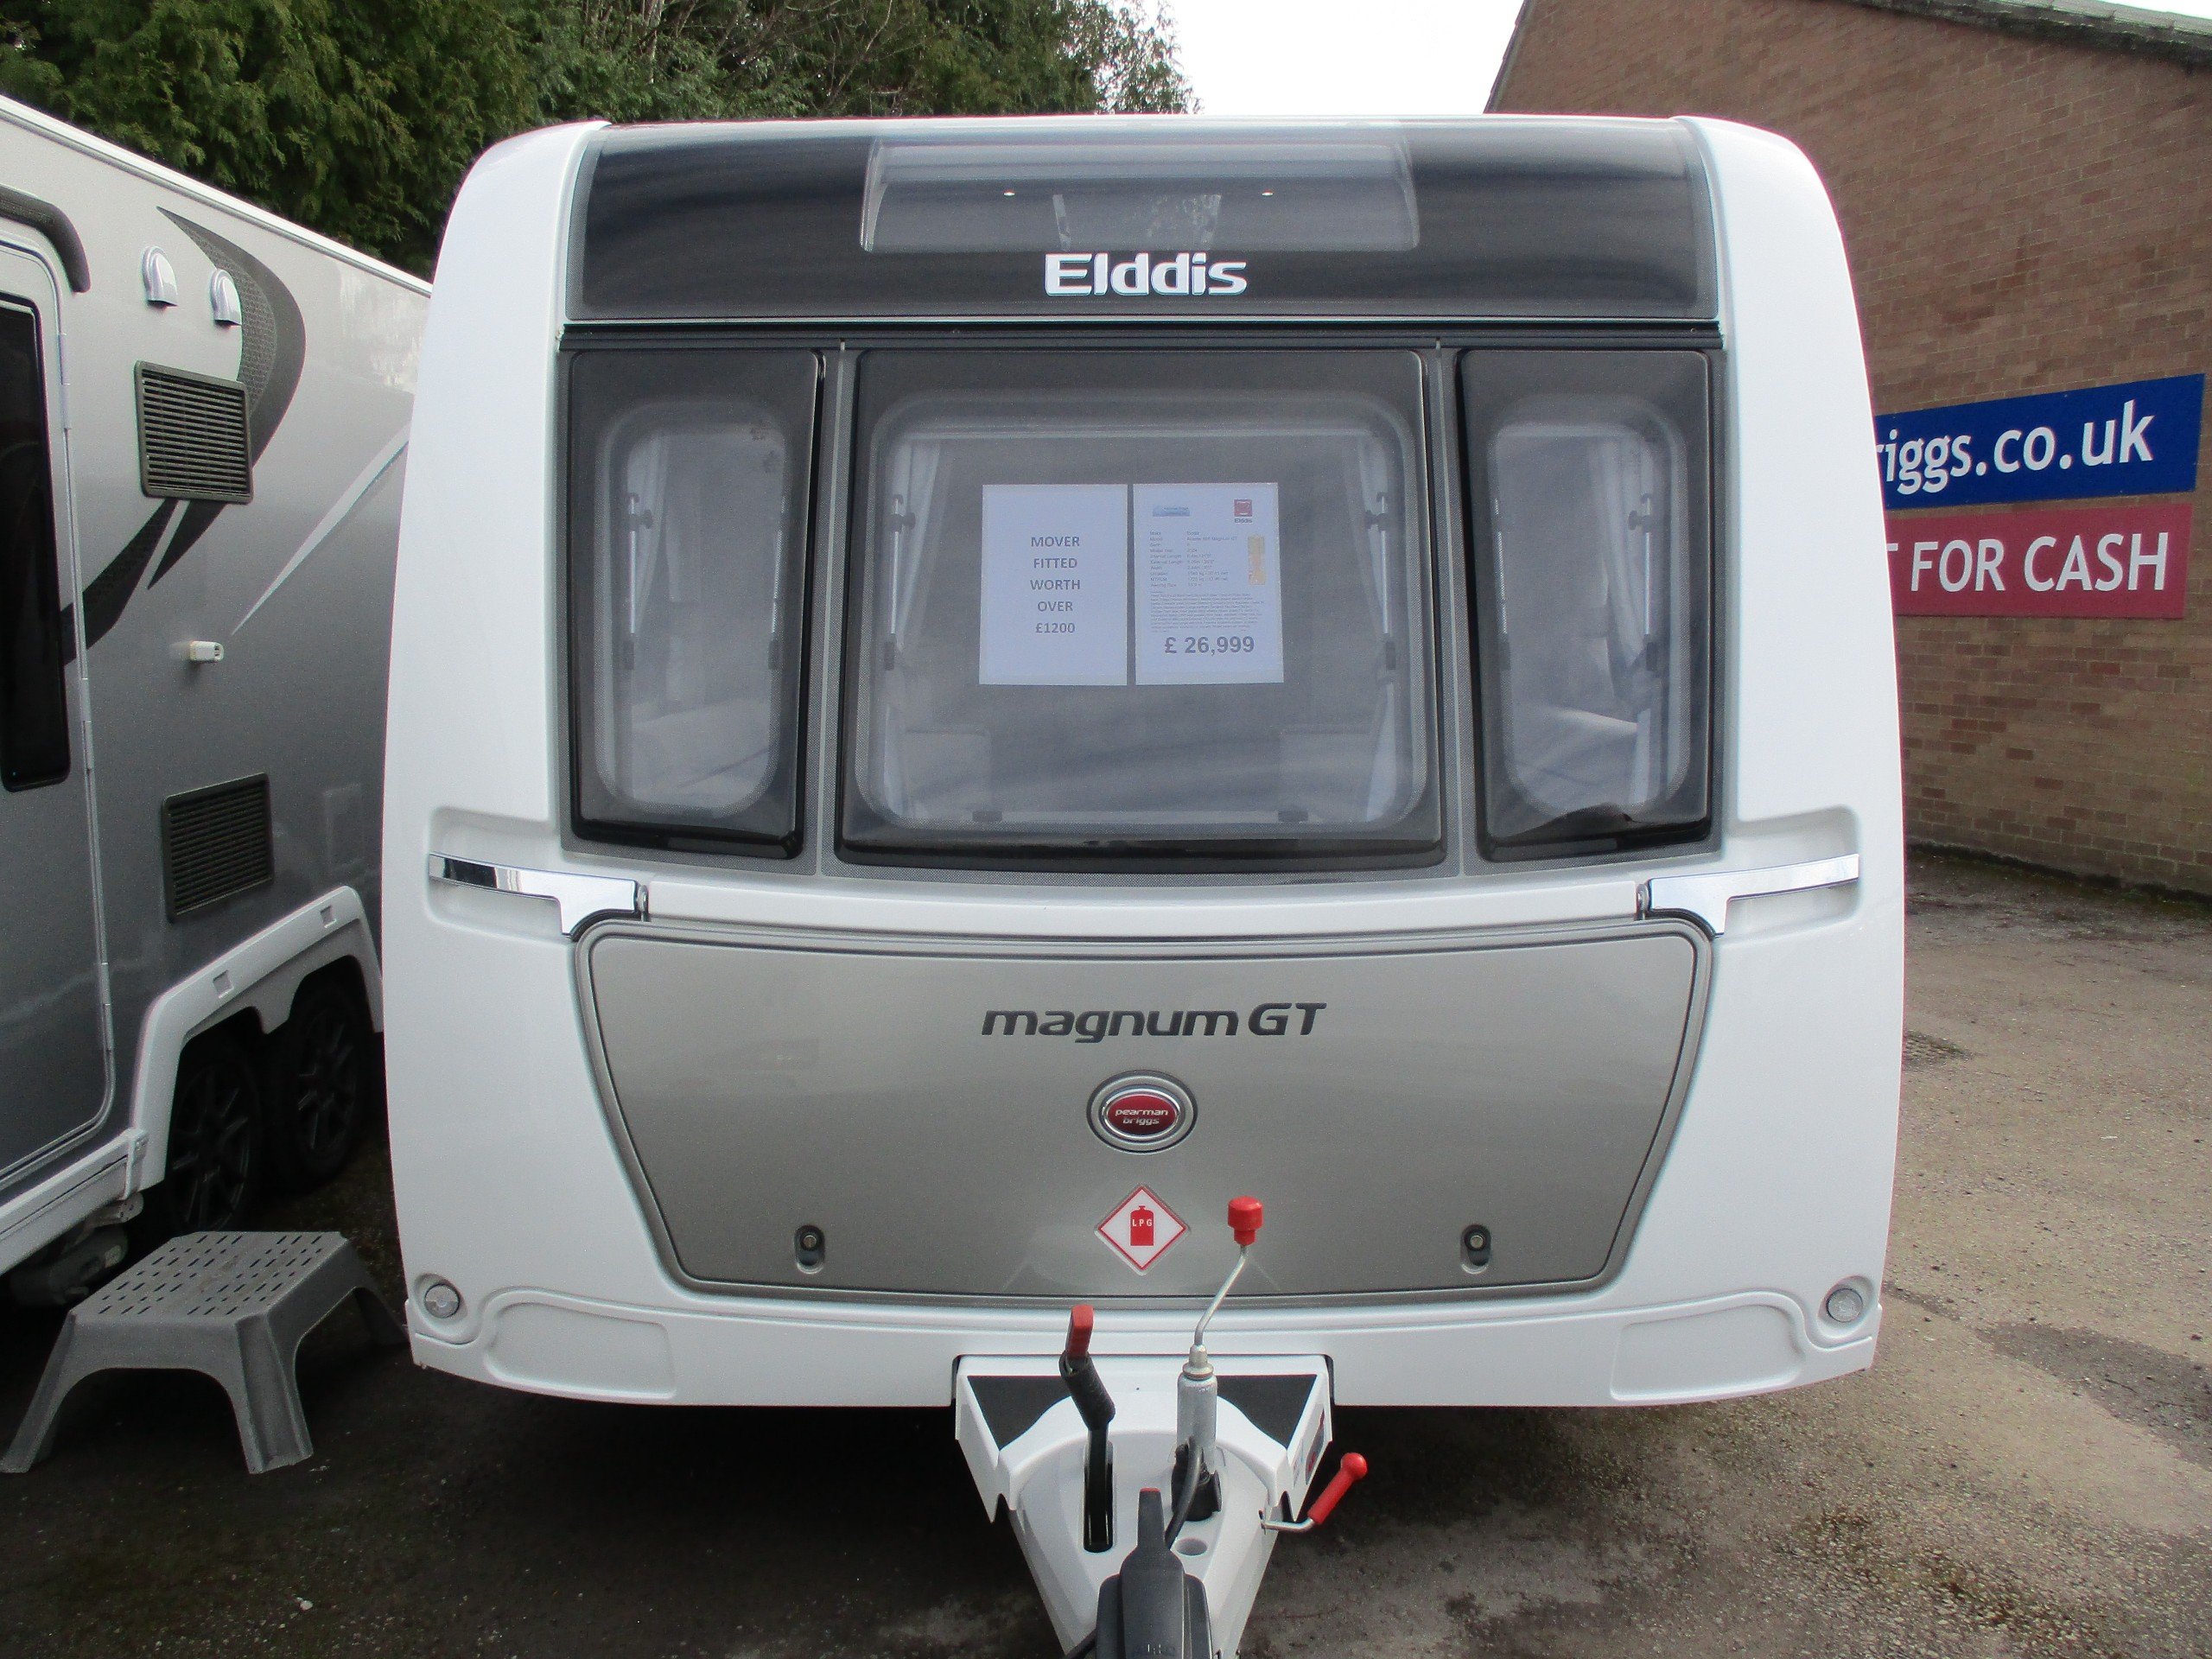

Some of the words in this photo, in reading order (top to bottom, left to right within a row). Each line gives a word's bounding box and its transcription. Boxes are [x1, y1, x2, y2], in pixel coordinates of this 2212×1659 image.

[1045, 252, 1247, 296] Elddis
[1876, 399, 2155, 494] iggs.co.uk
[1031, 536, 1080, 547] MOVER
[1033, 557, 1077, 569] FITTED
[1910, 538, 2005, 592] FOR
[2024, 531, 2169, 592] CASH
[1030, 579, 1081, 590] WORTH
[1037, 601, 1073, 612] OVER
[1035, 622, 1075, 633] £1200
[1164, 636, 1177, 654] £
[1184, 636, 1255, 657] 26,999
[982, 1010, 1239, 1043] magnum
[1122, 1116, 1160, 1126] briggs
